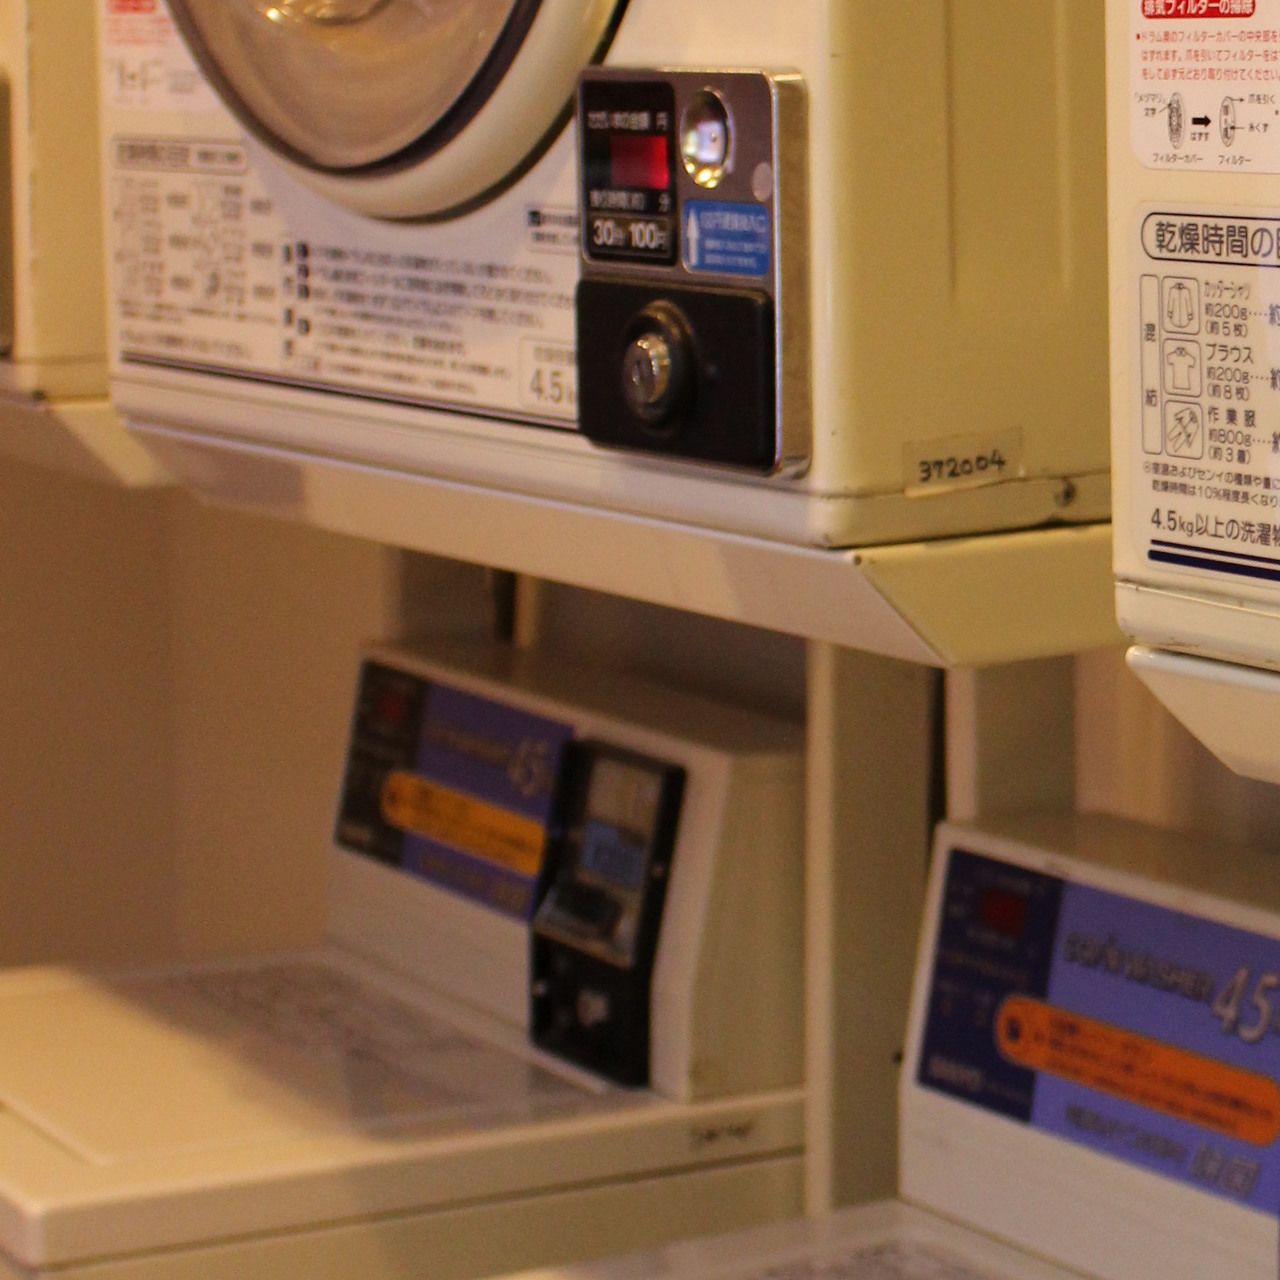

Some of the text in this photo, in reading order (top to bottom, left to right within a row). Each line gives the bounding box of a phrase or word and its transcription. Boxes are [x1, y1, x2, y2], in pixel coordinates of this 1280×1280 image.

[1206, 343, 1255, 365] ブラウス
[917, 448, 1006, 483] 372004
